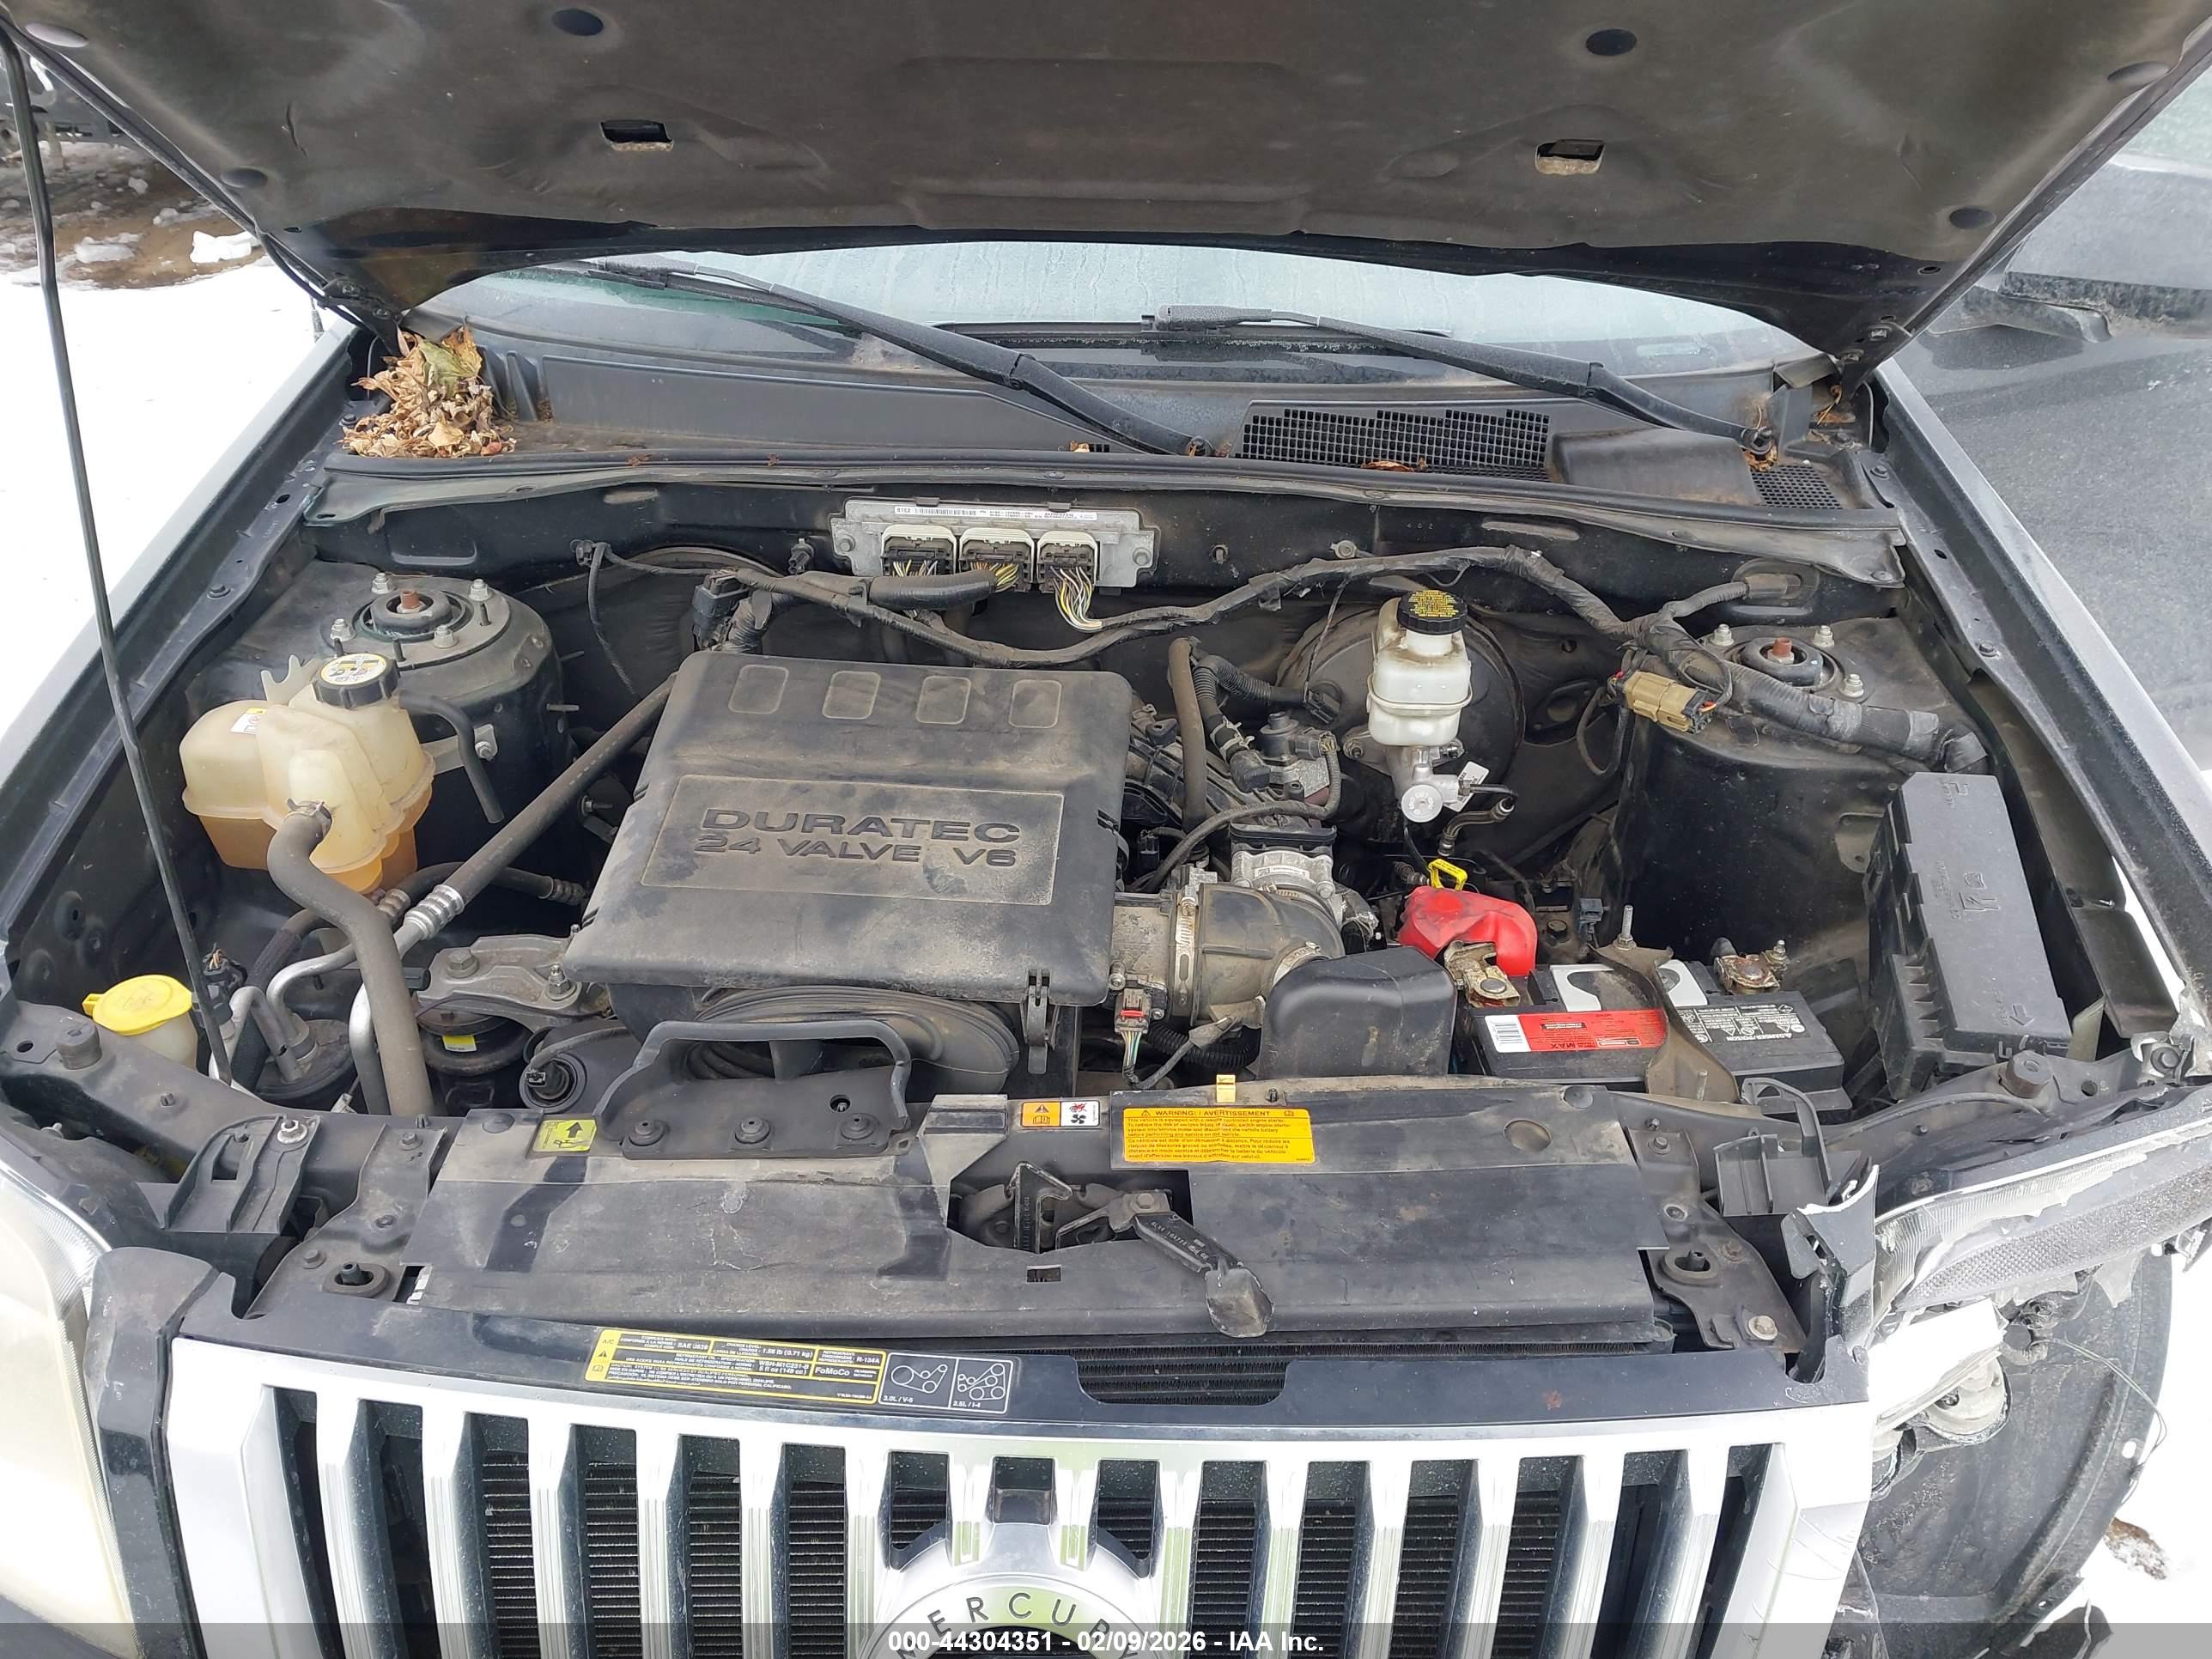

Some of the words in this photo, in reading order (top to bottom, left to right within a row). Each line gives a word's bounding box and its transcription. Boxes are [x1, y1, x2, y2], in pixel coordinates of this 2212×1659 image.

[702, 809, 1020, 842] DURATEC
[694, 834, 762, 854] 24
[777, 837, 921, 862] VALVE
[953, 847, 1017, 867] V6
[814, 1366, 850, 1376] FoMoCo
